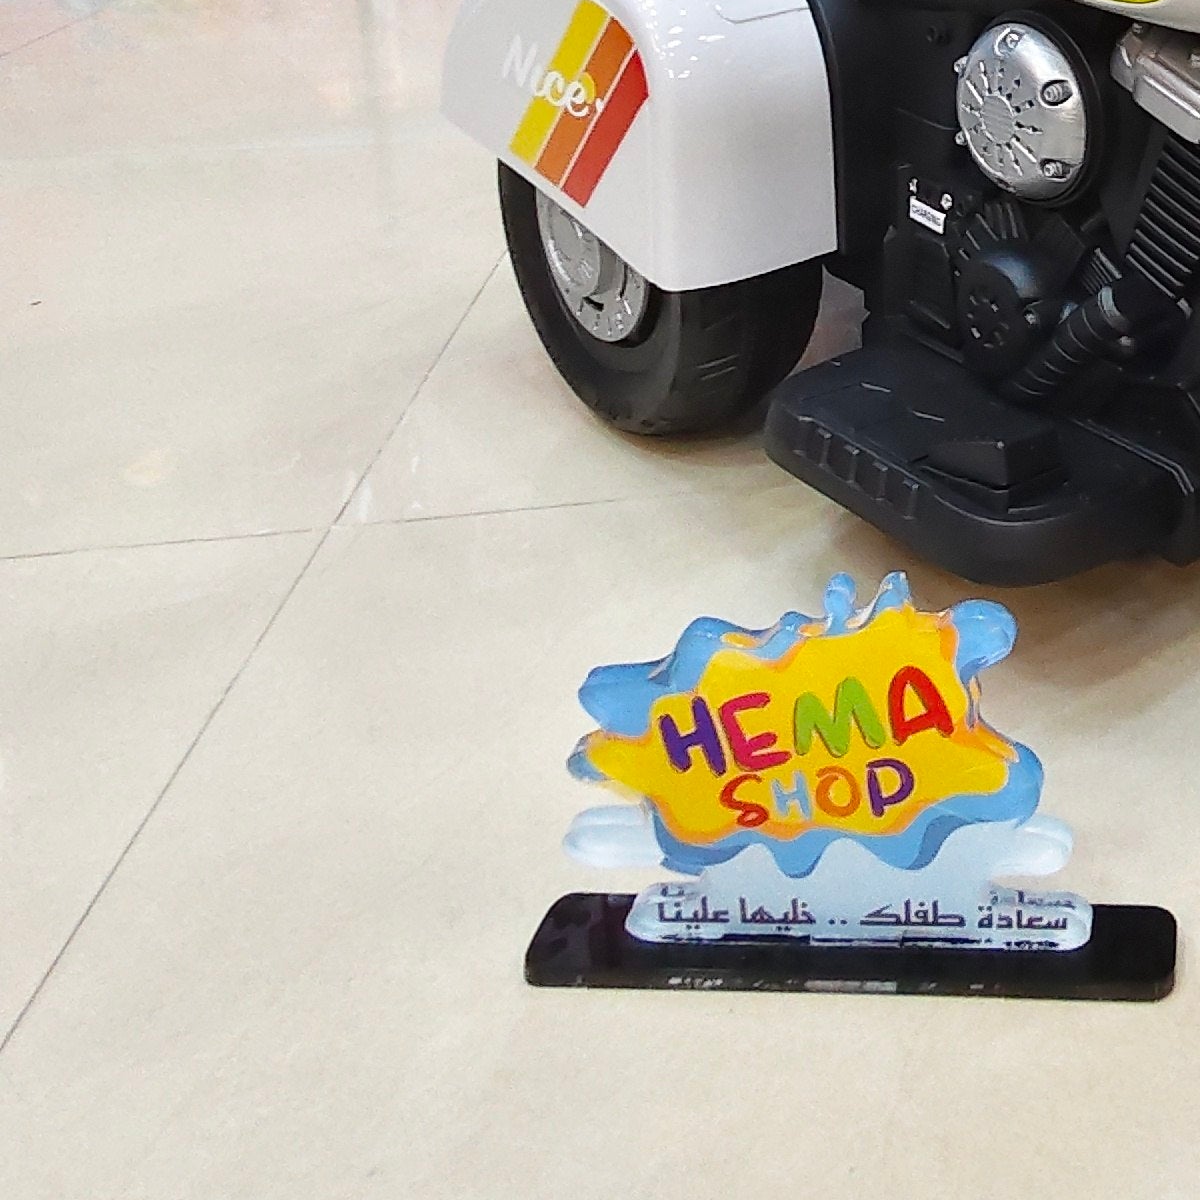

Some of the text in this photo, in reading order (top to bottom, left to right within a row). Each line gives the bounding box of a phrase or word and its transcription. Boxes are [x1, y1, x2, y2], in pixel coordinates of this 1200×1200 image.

[656, 665, 956, 775] HEMA
[719, 757, 918, 827] SHOP
[656, 895, 731, 931] علينا
[739, 896, 816, 931] خليها
[859, 898, 965, 928] طفلك
[977, 905, 1068, 931] سعادة
